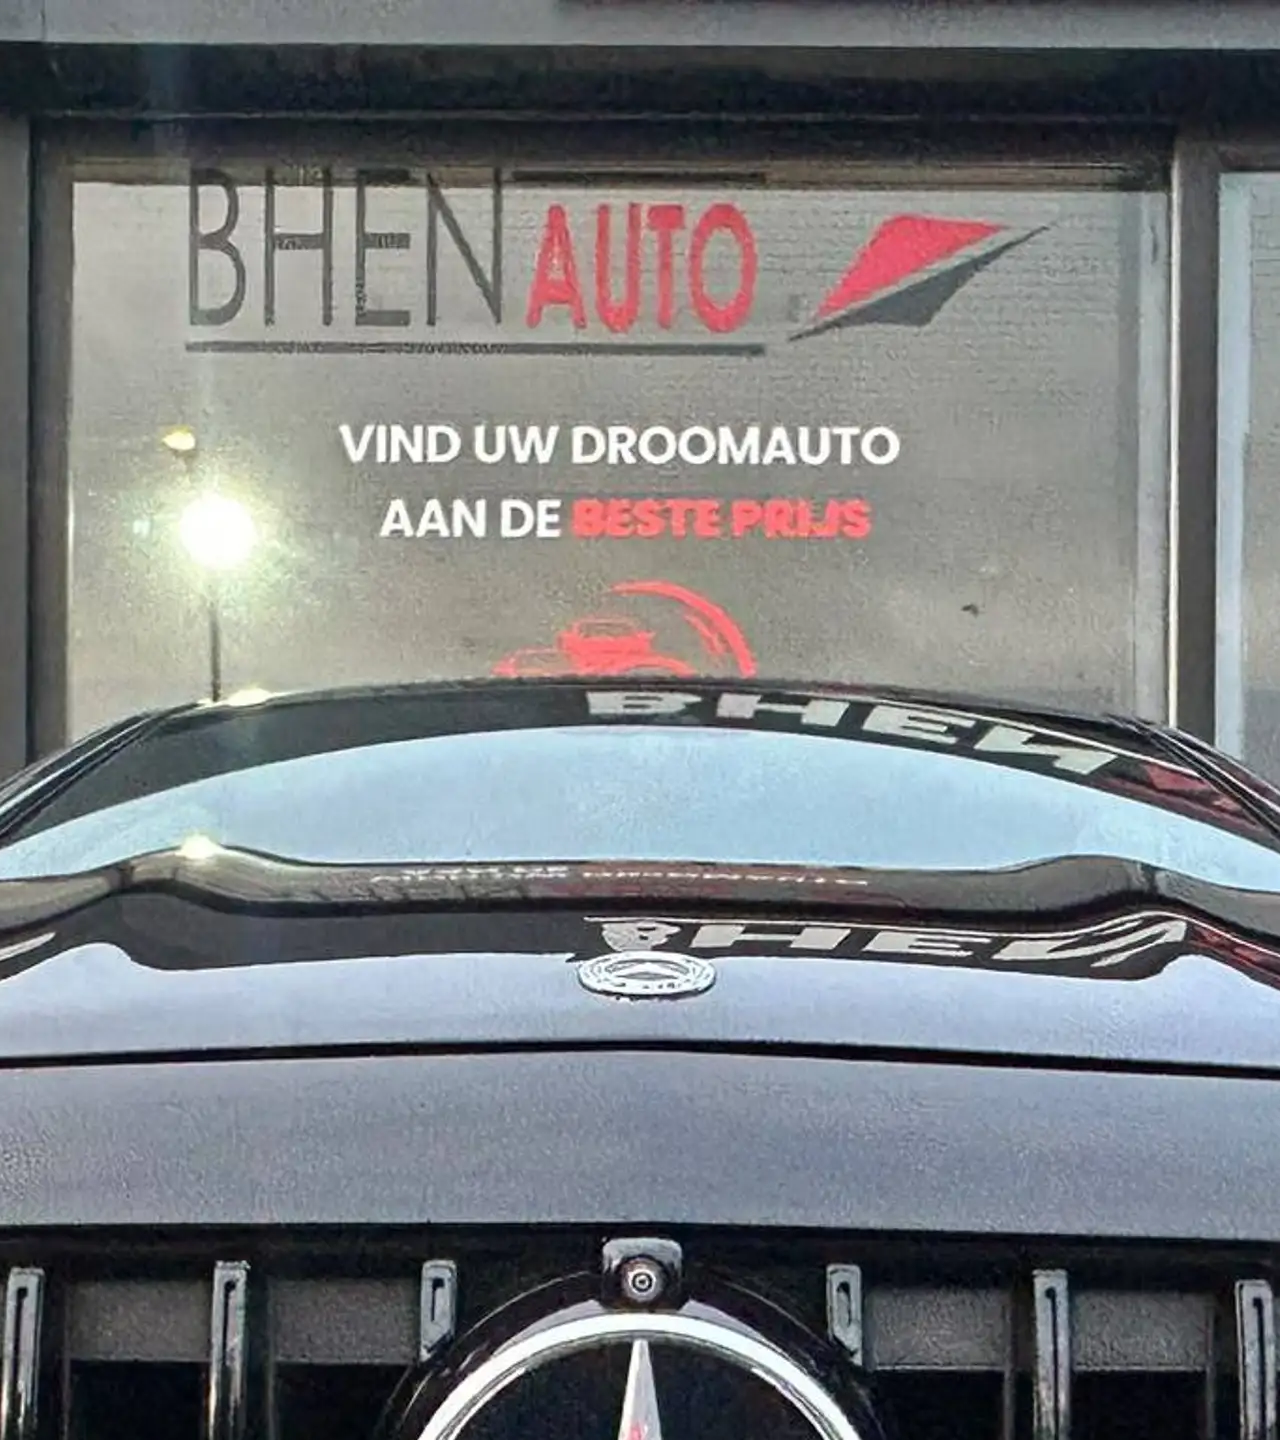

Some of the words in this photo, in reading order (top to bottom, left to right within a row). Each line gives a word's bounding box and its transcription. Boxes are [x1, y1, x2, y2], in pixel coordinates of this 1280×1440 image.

[189, 167, 503, 327] BHEN
[526, 202, 757, 332] AUTO
[339, 424, 462, 464] VIND
[474, 425, 559, 464] UW
[572, 425, 901, 465] DROOMAUTO
[379, 498, 487, 538] AAN
[500, 499, 561, 538] DE
[571, 498, 721, 540] BESTE
[730, 499, 870, 539] PRIJS
